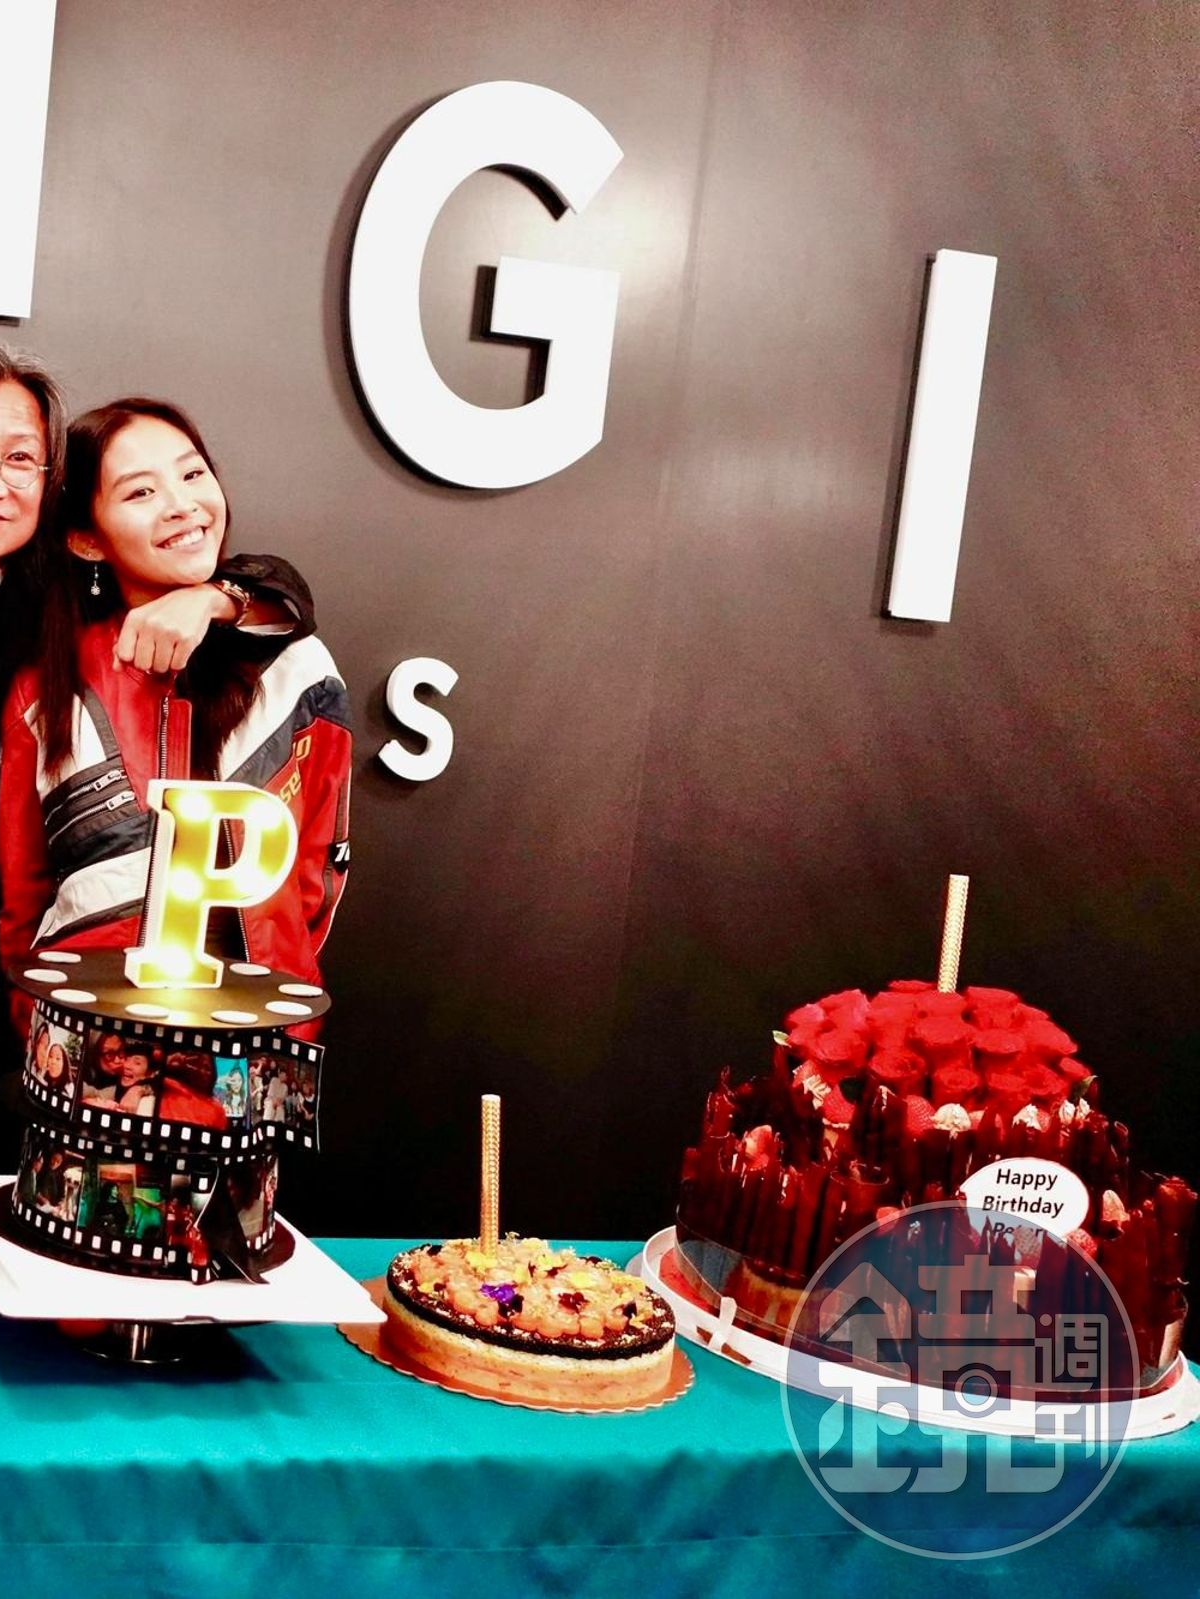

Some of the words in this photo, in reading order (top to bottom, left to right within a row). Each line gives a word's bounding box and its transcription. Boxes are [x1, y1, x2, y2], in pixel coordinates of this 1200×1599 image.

[125, 779, 298, 989] P
[996, 1168, 1058, 1191] Happy
[982, 1195, 1064, 1219] Birthday
